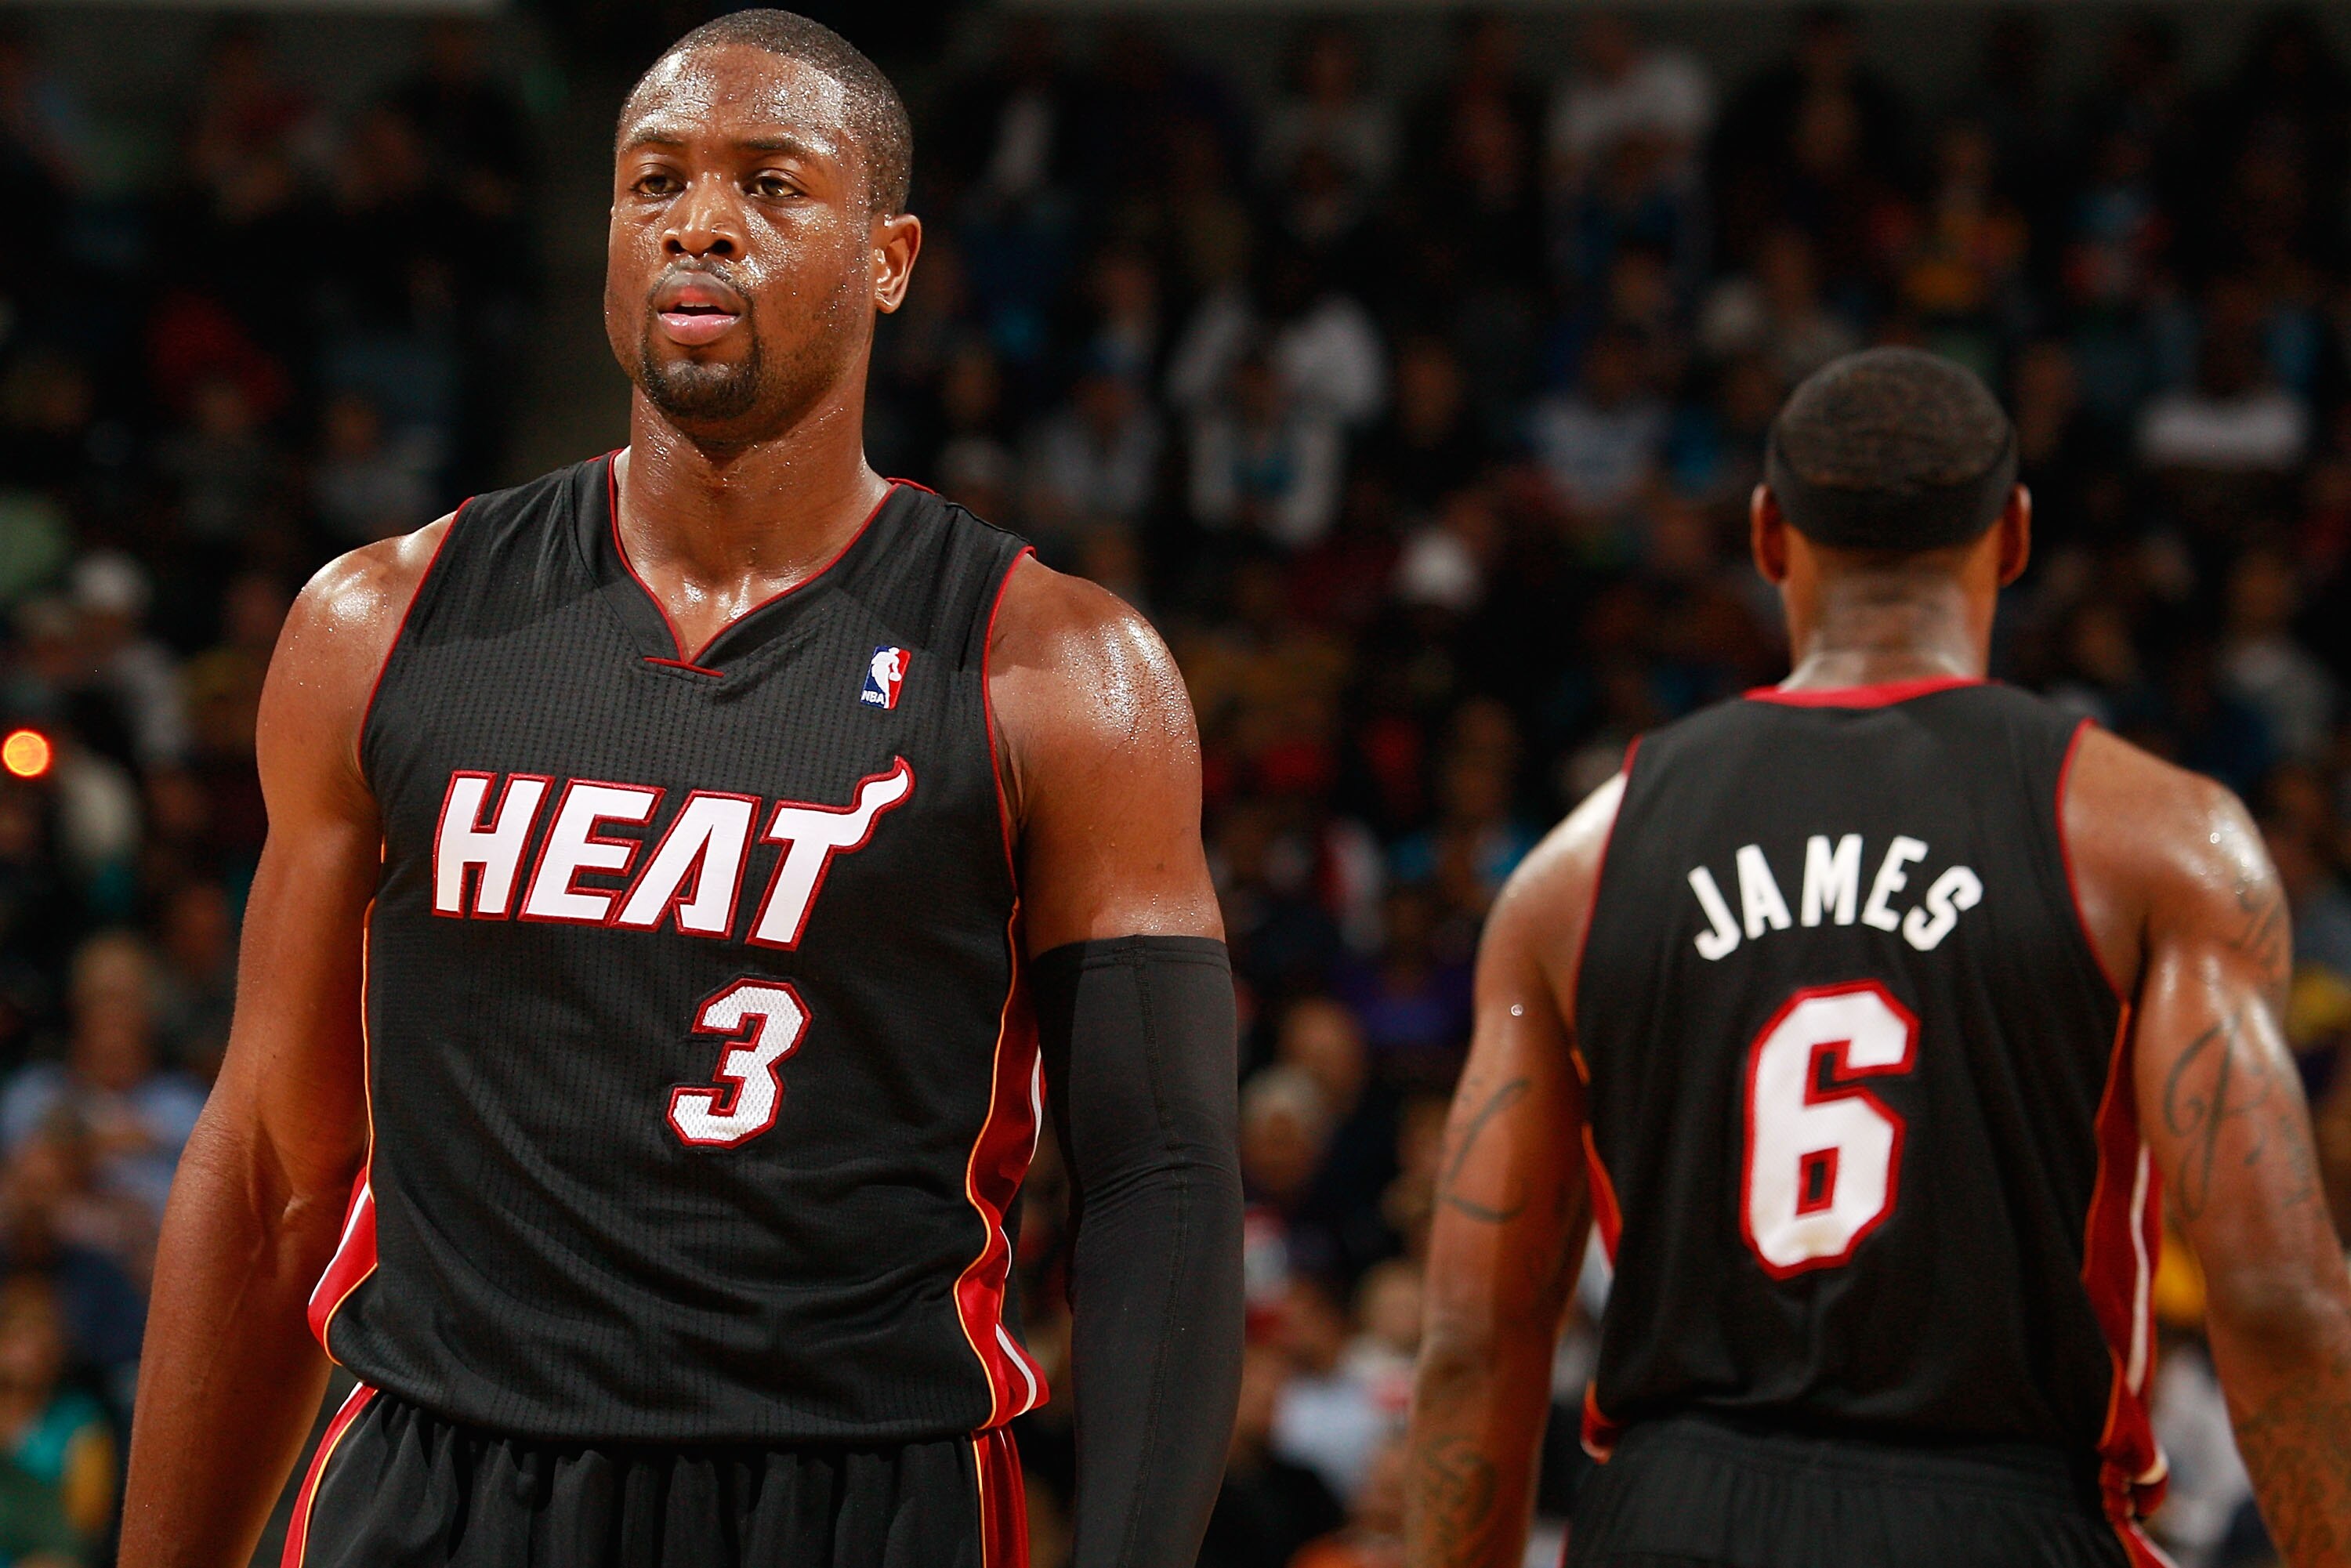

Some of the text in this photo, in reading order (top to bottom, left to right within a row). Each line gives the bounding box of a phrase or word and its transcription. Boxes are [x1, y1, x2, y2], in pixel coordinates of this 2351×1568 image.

[860, 690, 885, 704] NBA
[432, 755, 915, 951] HEAT
[1687, 833, 1983, 961] JAMES
[665, 976, 813, 1149] 3
[1739, 978, 1921, 1280] 6
